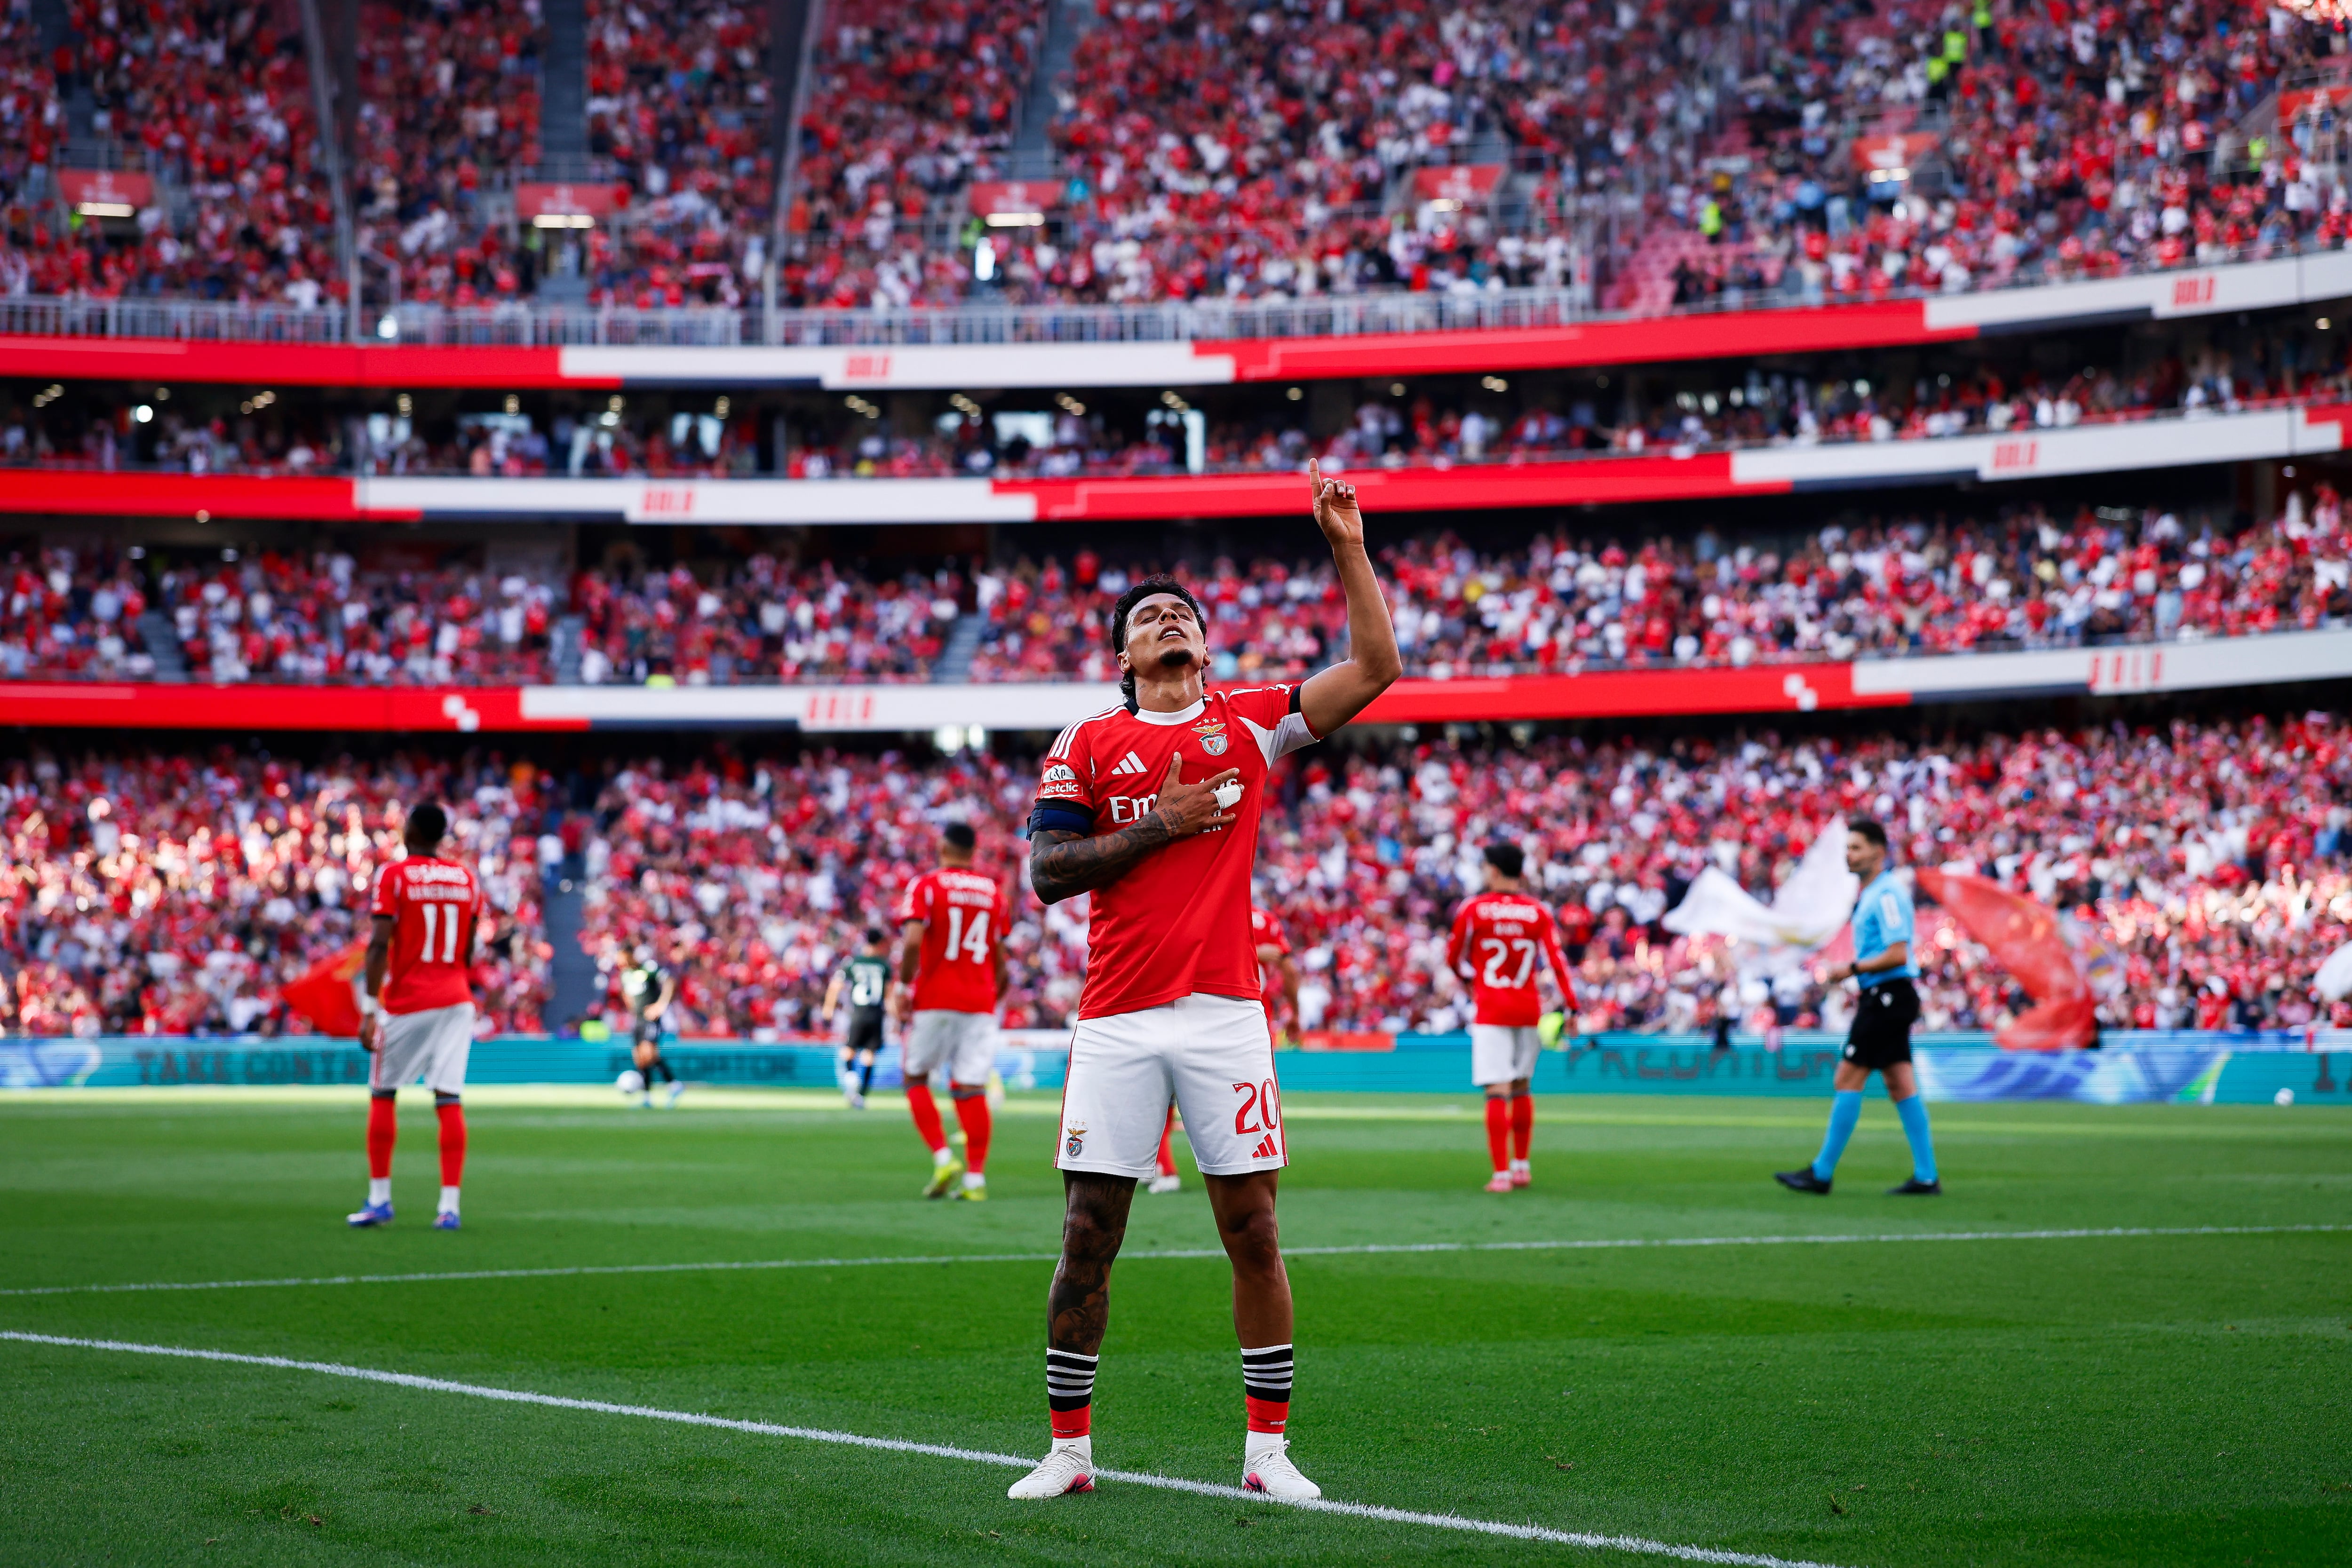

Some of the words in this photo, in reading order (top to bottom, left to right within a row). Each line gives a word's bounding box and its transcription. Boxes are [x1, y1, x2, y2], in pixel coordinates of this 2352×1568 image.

[1043, 782, 1079, 795] Betclic
[420, 903, 459, 963] 11
[944, 906, 991, 964] 14
[1480, 938, 1536, 990] 27
[1232, 1078, 1279, 1135] 20
